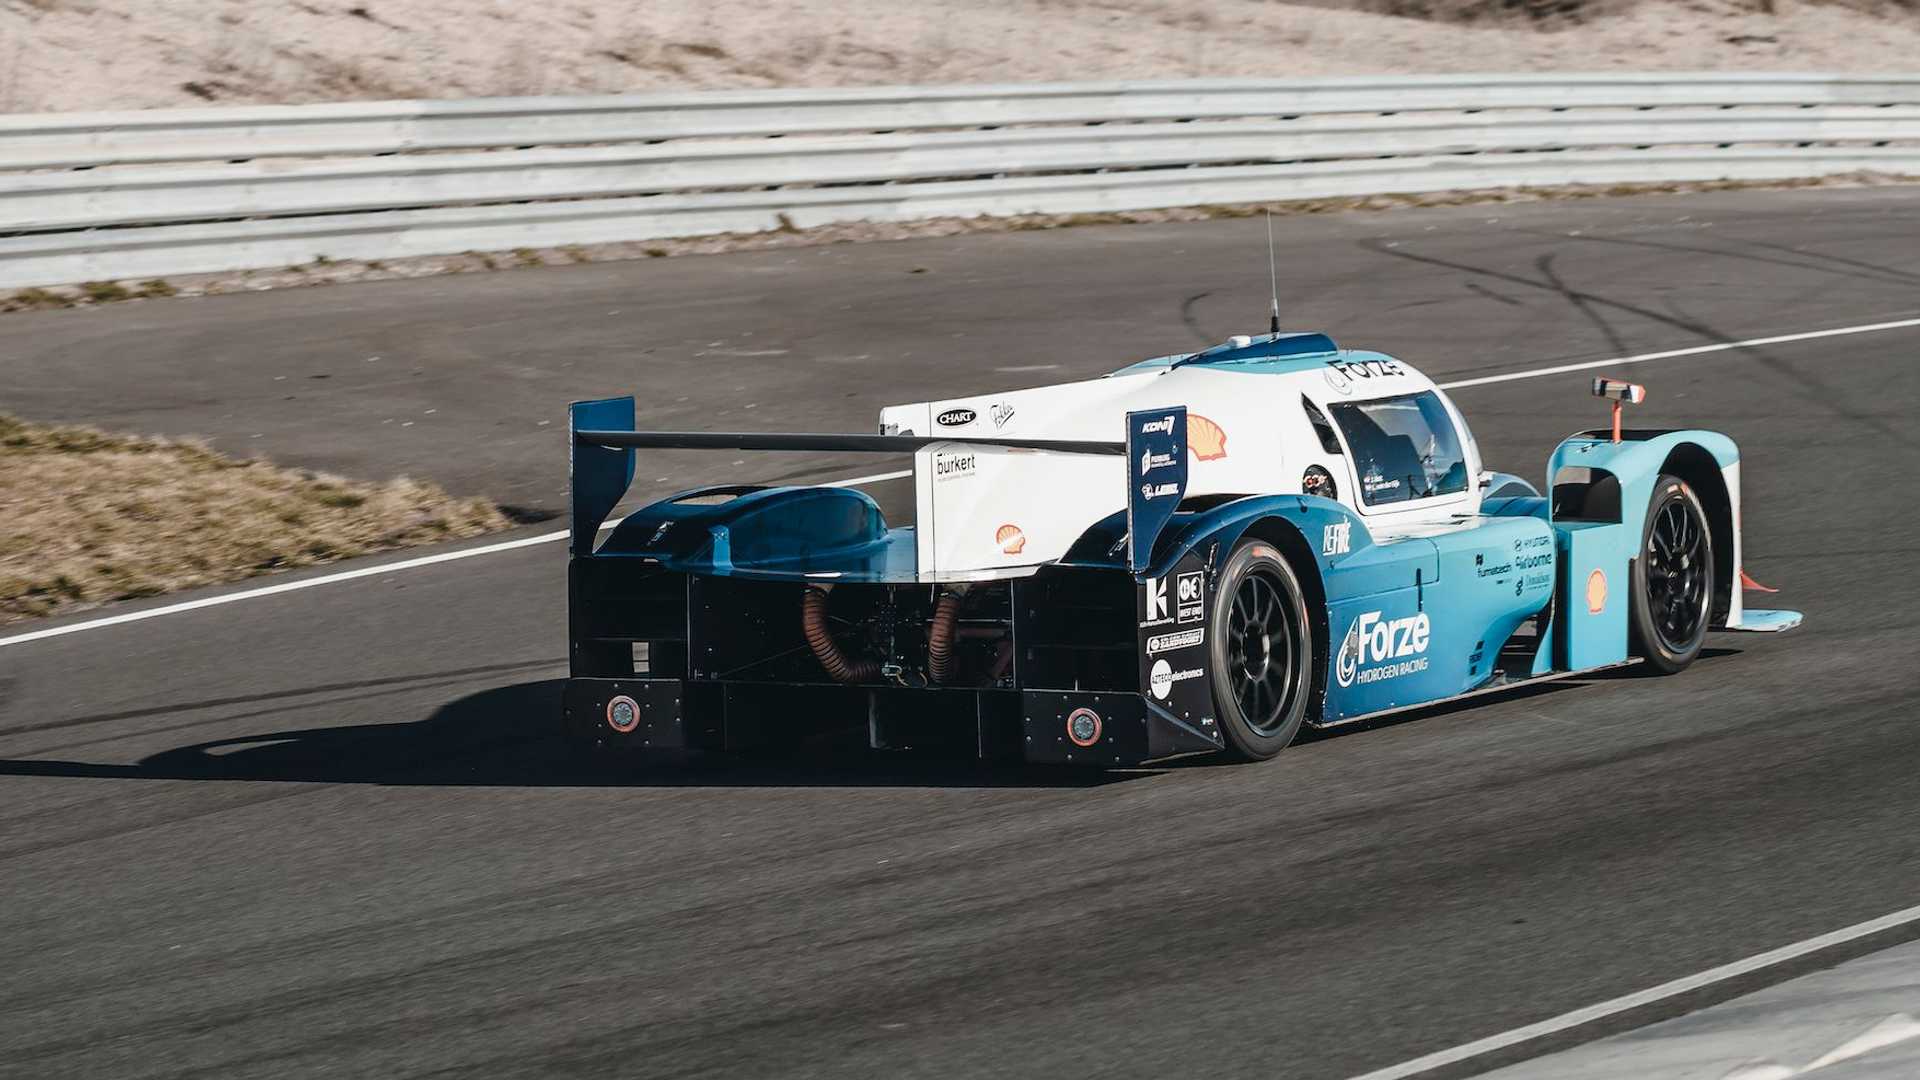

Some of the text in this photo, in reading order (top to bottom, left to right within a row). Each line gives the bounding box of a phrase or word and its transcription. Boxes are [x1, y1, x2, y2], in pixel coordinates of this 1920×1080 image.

[1325, 359, 1405, 382] Forze
[939, 411, 973, 424] CHART
[1146, 576, 1168, 621] K
[1357, 610, 1430, 665] Forze
[1357, 657, 1429, 685] HYDROGEN RACING
